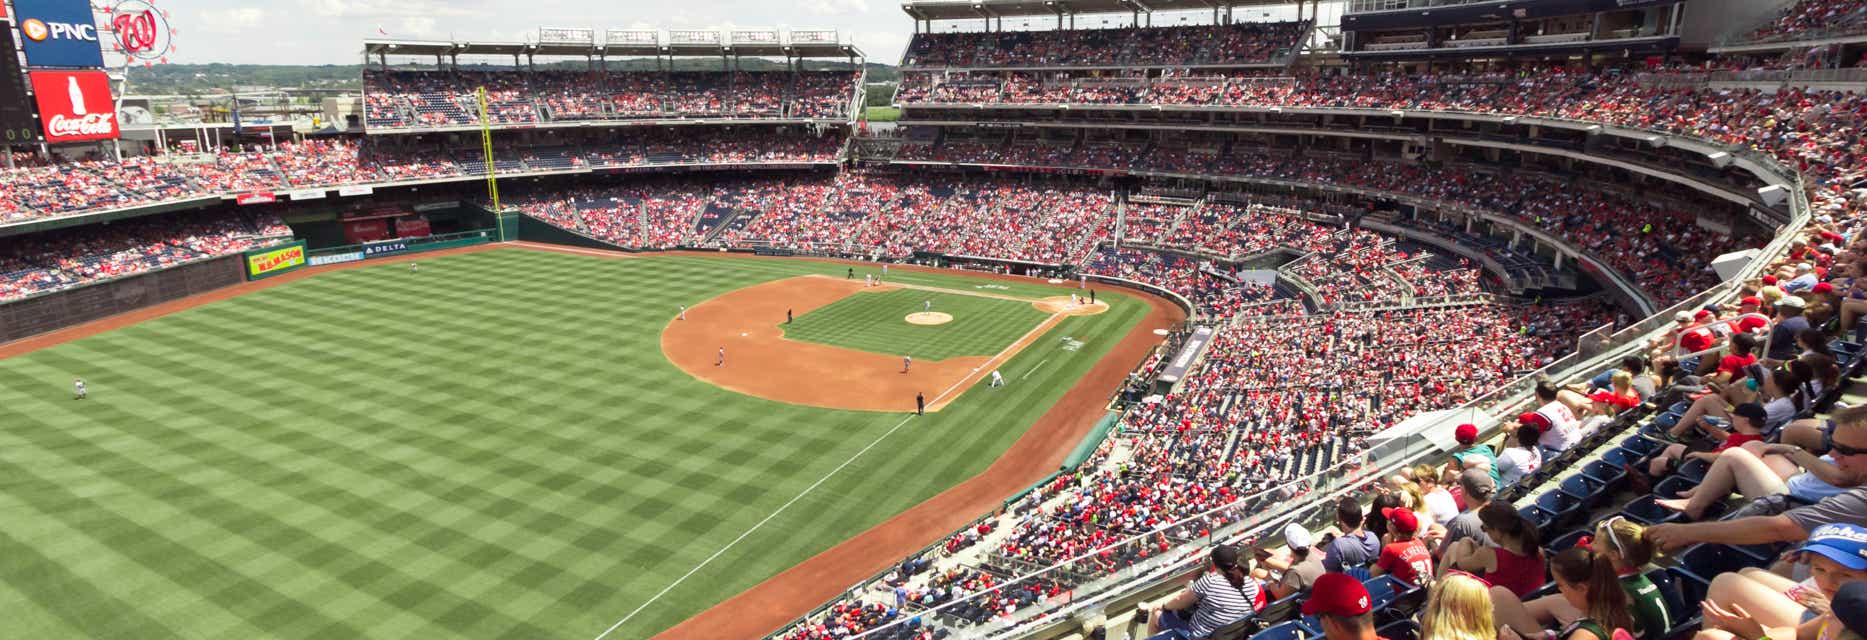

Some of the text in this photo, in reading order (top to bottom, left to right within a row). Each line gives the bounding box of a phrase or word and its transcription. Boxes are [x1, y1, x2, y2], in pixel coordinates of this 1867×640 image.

[48, 22, 97, 41] PNC
[49, 113, 113, 137] Coca-Cola
[375, 243, 406, 253] DELTA
